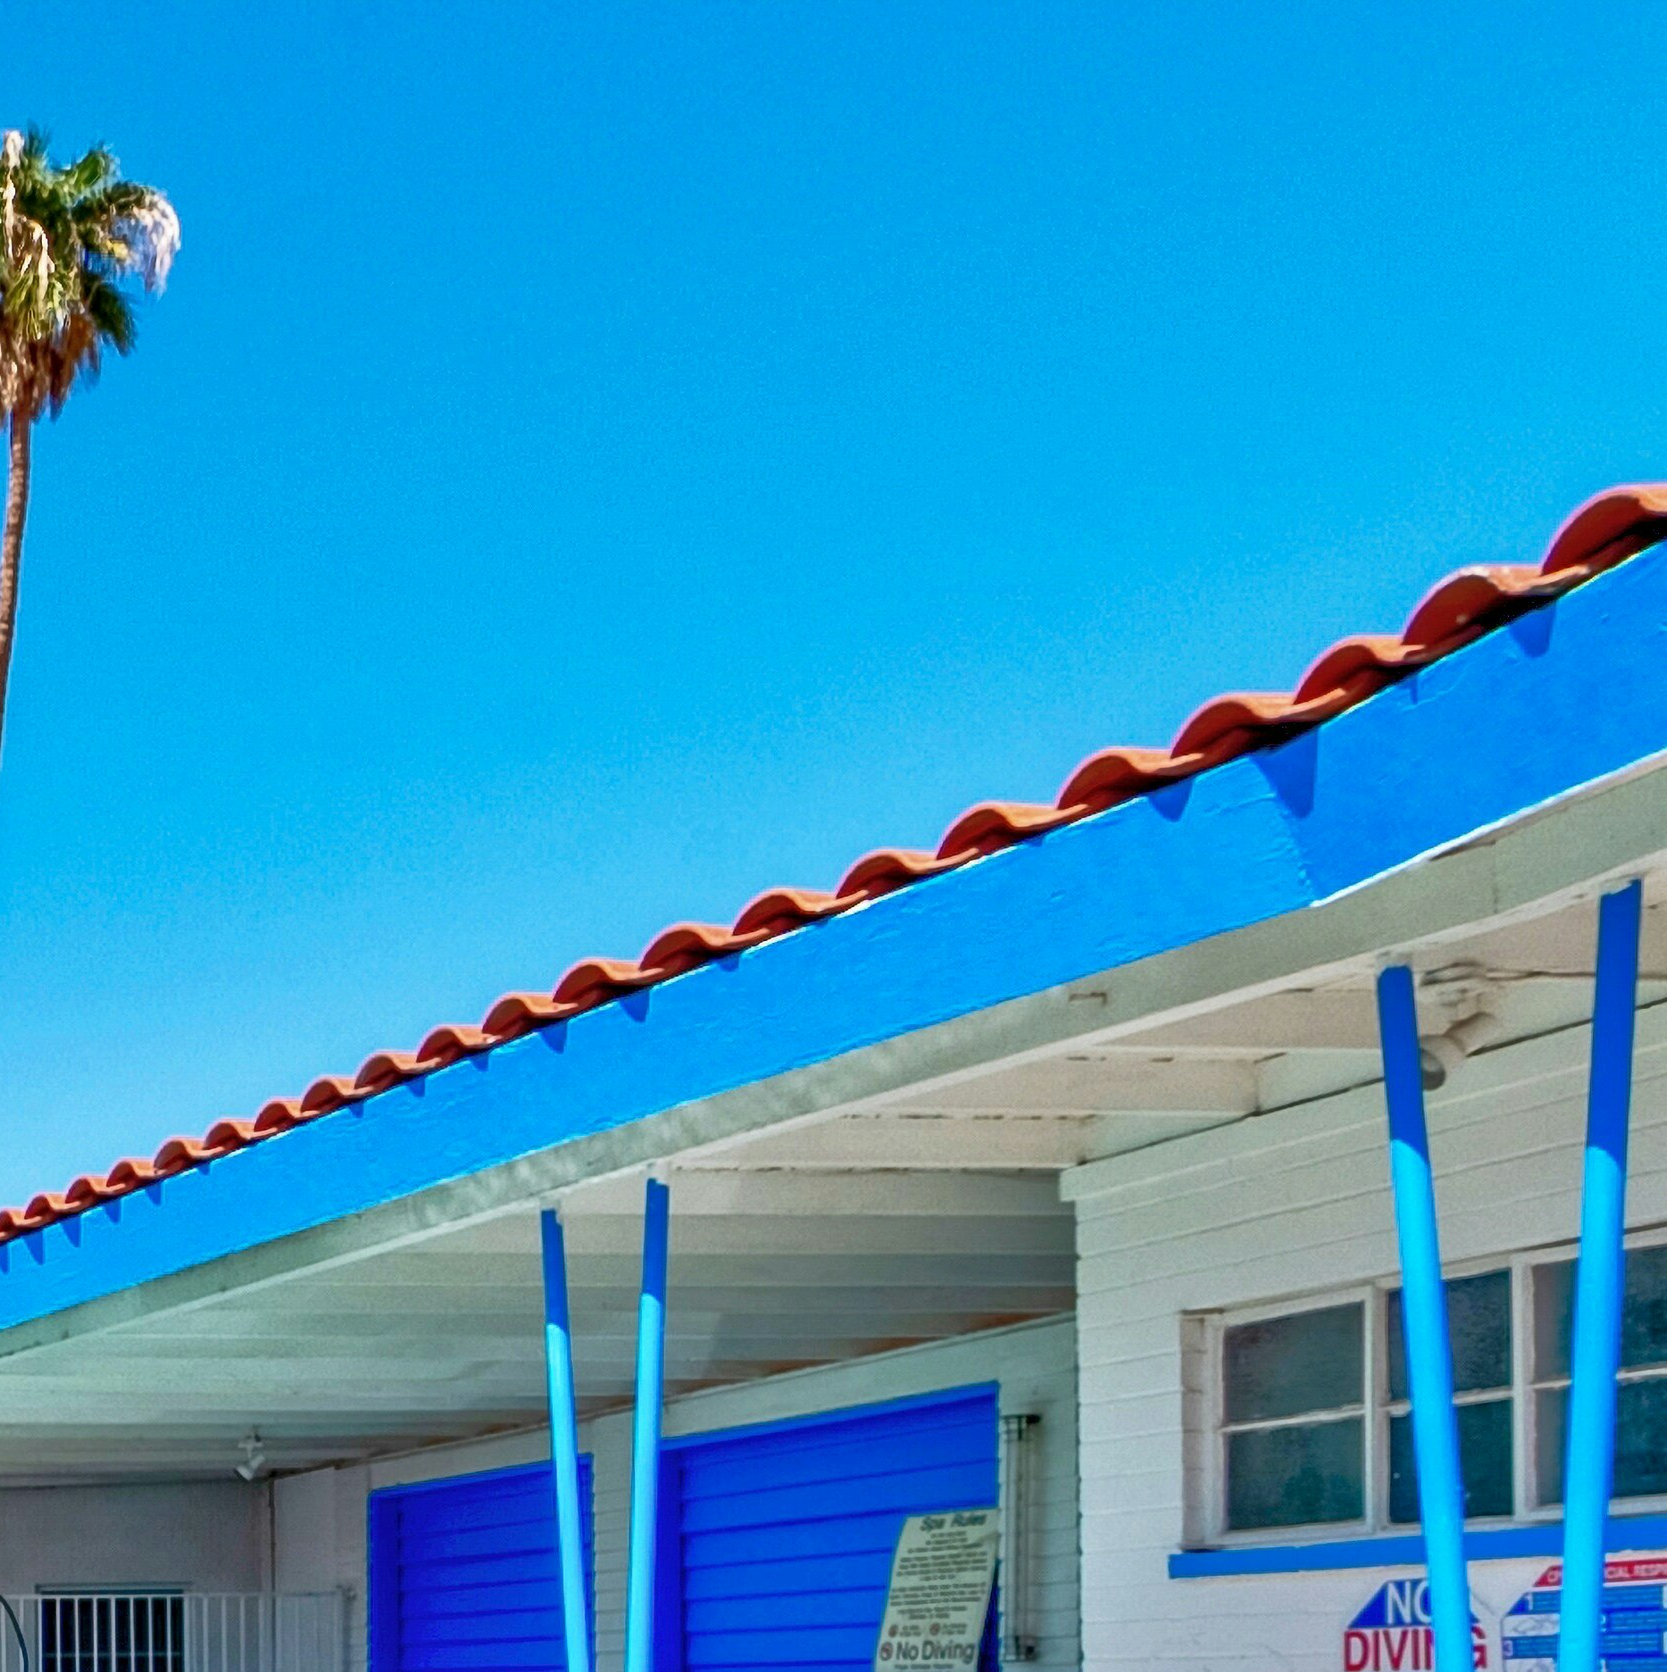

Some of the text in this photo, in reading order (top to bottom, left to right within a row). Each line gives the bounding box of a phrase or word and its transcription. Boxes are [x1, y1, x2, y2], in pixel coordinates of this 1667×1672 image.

[1386, 1579, 1433, 1625] NO
[896, 1639, 975, 1665] No Diving
